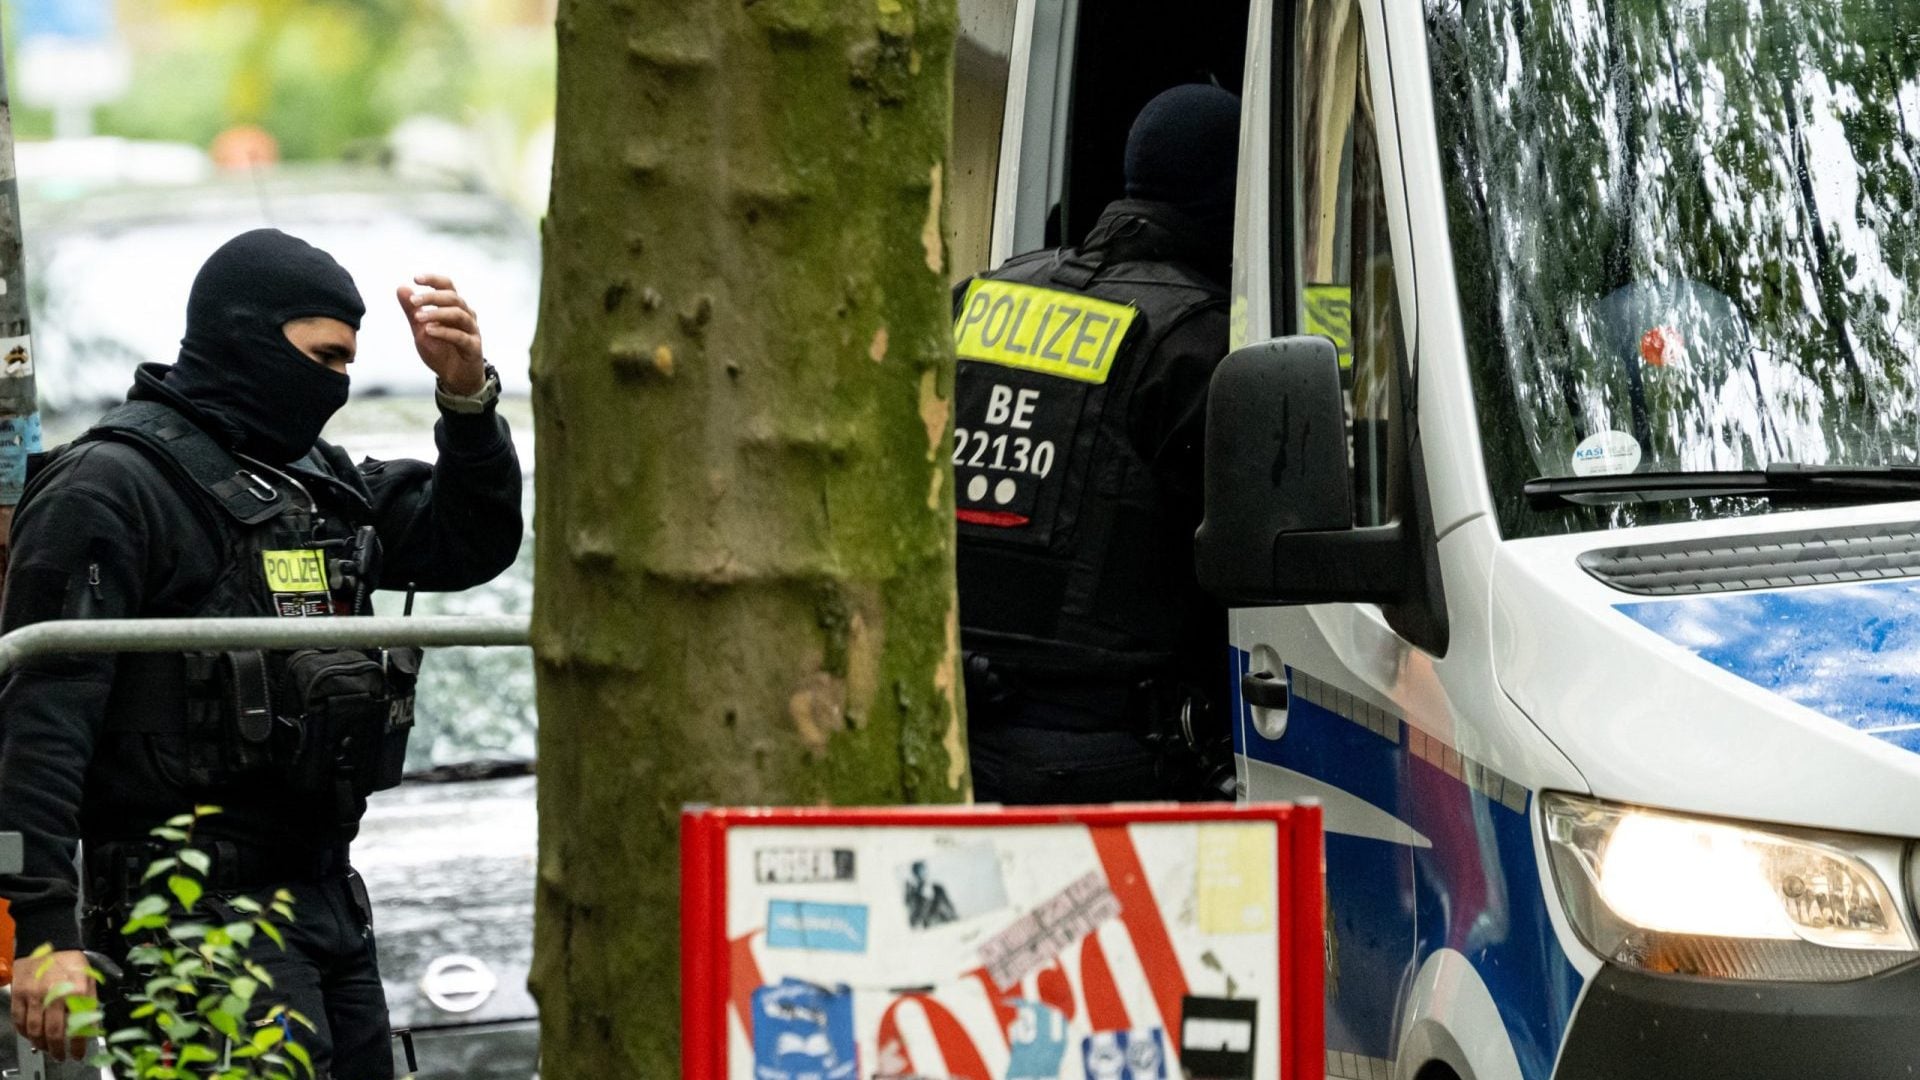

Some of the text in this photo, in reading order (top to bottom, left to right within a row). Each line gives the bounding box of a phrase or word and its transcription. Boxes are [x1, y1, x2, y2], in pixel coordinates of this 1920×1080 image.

[958, 292, 1120, 370] POLIZEI
[985, 384, 1040, 430] BE
[951, 428, 1055, 479] 22130
[267, 557, 322, 584] POLIZE
